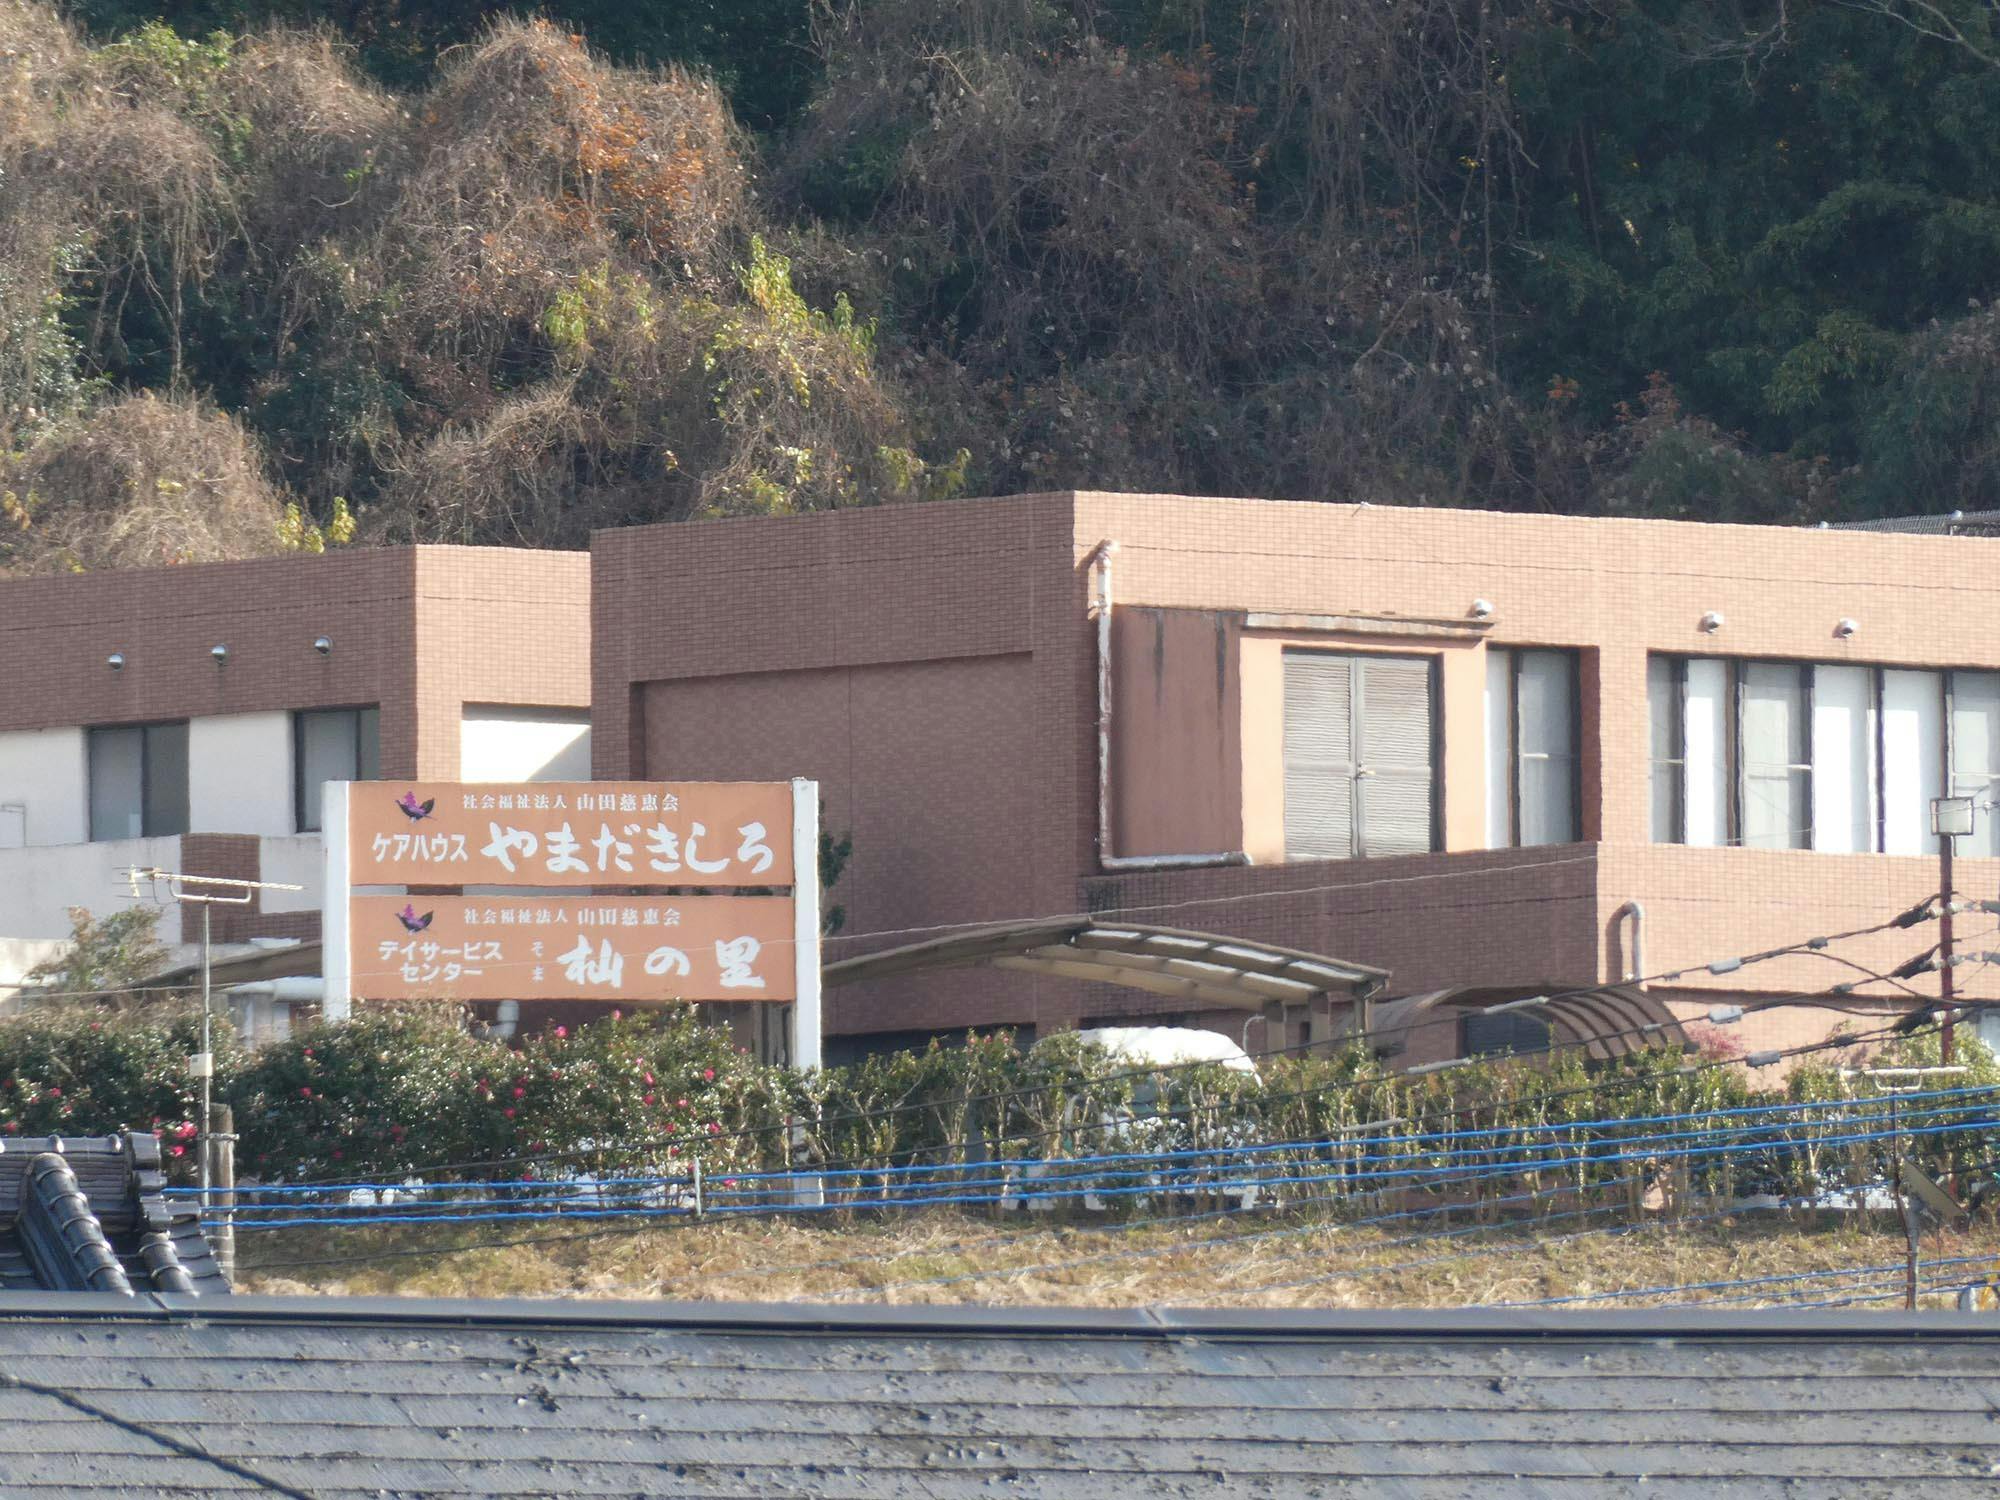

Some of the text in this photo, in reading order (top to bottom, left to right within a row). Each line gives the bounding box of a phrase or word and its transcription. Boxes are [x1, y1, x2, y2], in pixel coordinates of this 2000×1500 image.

[463, 793, 567, 810] 社会福祉法人
[371, 821, 775, 873] ケアハウス やまだきしろ
[464, 908, 569, 926] 社会福祉法人
[378, 941, 503, 962] デイサービス
[399, 962, 483, 982] センター
